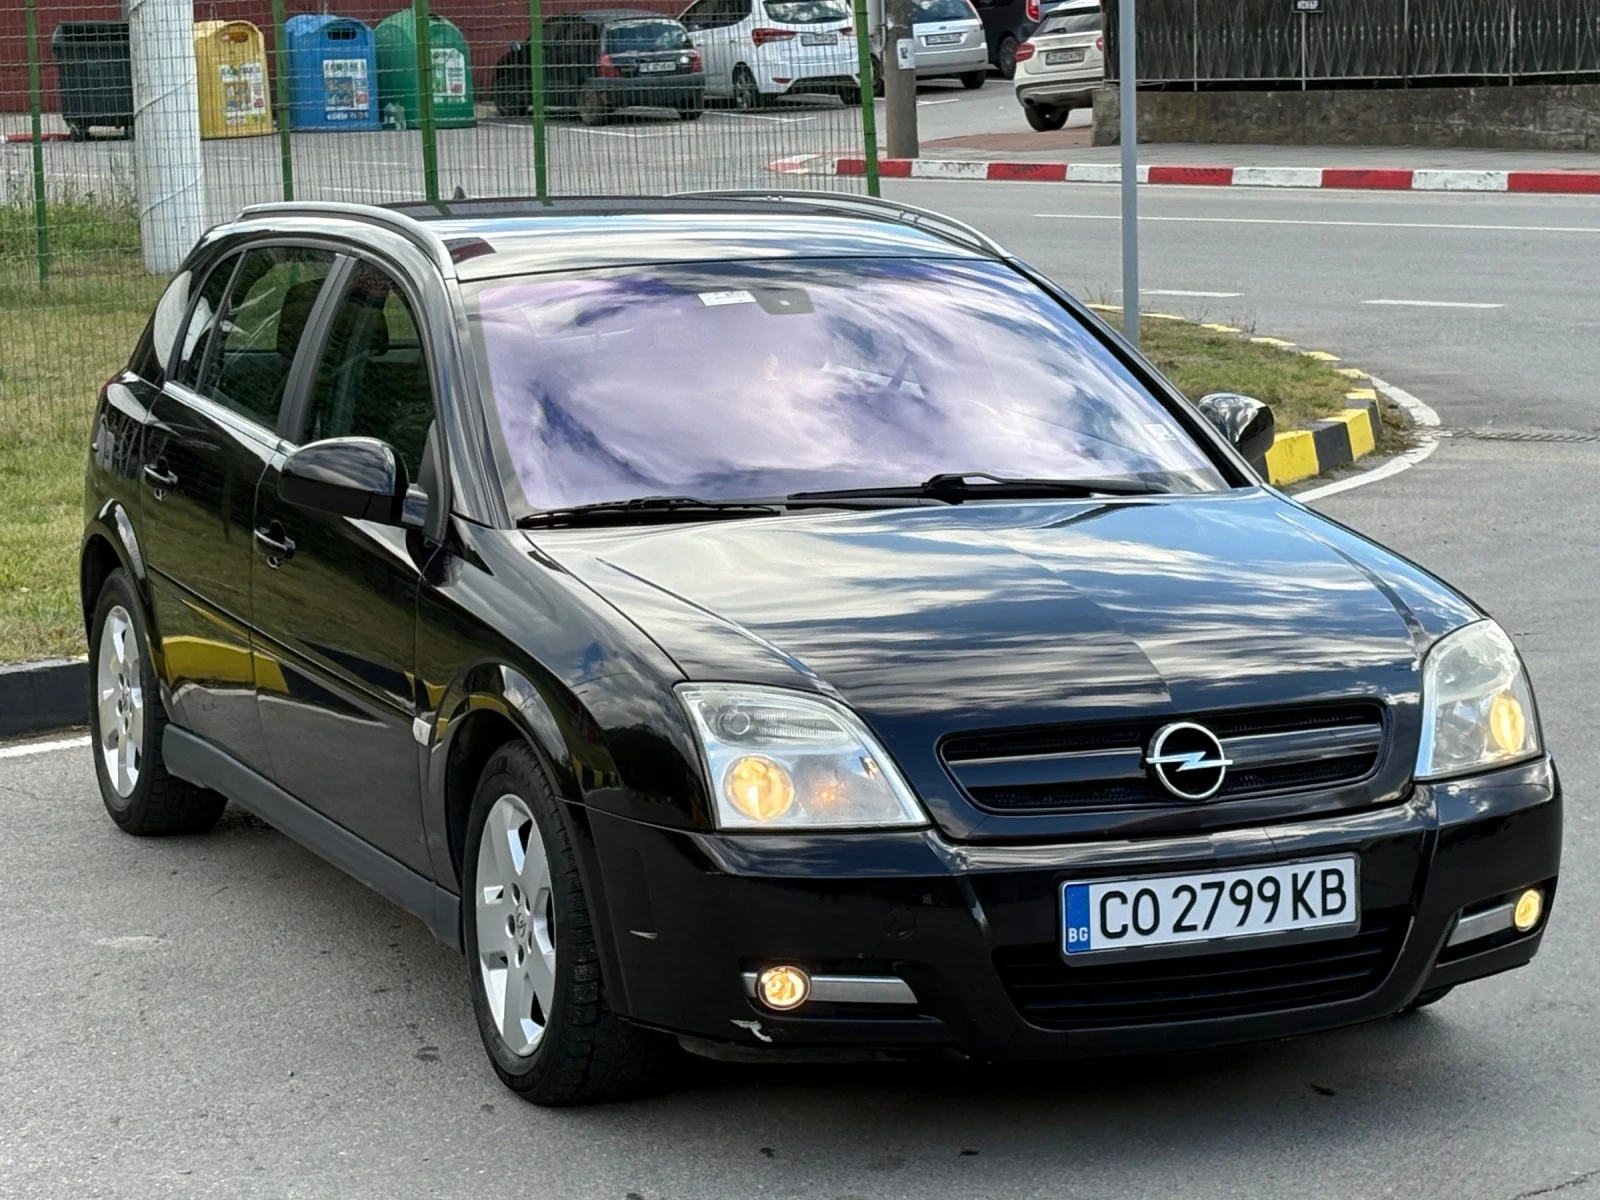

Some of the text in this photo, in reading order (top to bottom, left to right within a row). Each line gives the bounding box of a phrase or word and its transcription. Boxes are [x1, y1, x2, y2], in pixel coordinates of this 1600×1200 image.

[1100, 868, 1347, 939] CO 2799 KB
[1068, 928, 1088, 943] BG
